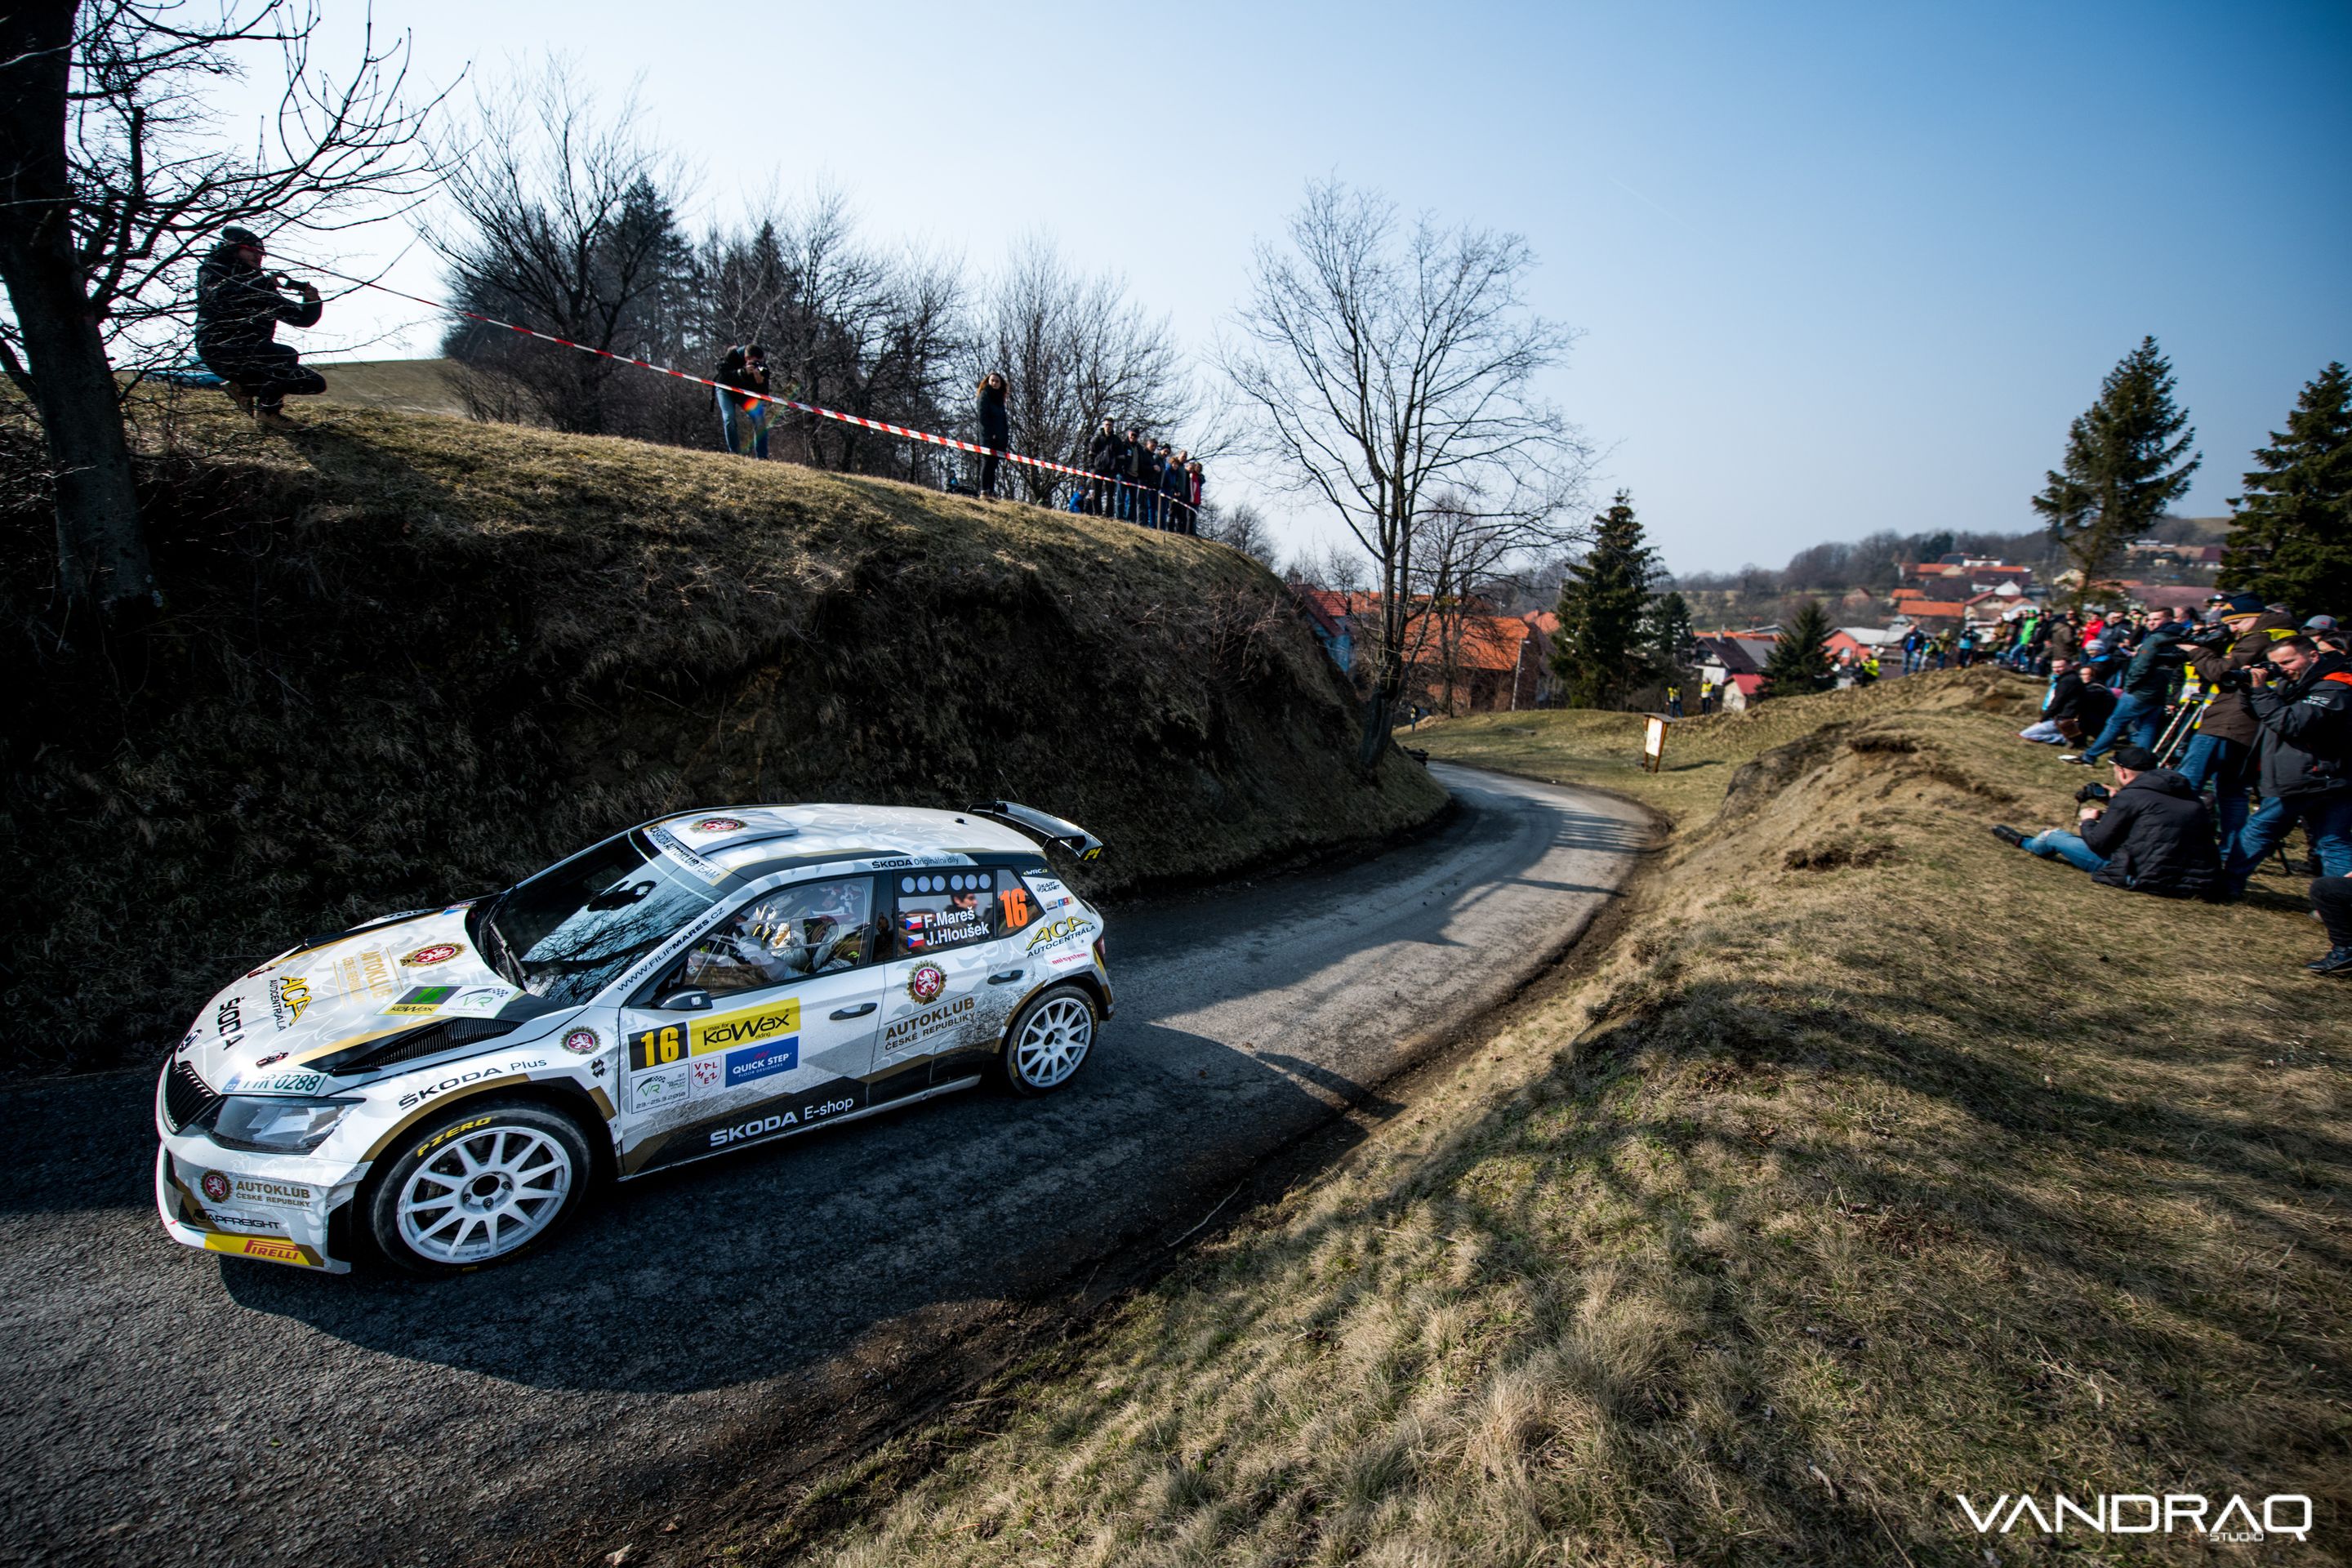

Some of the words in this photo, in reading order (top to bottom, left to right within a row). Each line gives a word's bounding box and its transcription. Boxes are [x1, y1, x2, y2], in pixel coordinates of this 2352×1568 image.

[694, 862, 720, 880] TEAM
[871, 859, 913, 869] ŠKODA
[924, 906, 975, 929] F.Mareš
[999, 888, 1028, 929] 16
[926, 921, 990, 946] J.Hloušek
[1026, 915, 1093, 951] ACA
[1027, 925, 1096, 958] AUTOCENTRÁLA
[279, 977, 313, 1027] ACA
[412, 987, 448, 1004] 16
[885, 997, 975, 1041] AUTOKLUB
[885, 1031, 918, 1051] ČESKÉ
[922, 1012, 976, 1036] REPUBLIKY
[640, 1027, 679, 1067] 16
[733, 1059, 765, 1075] QUICK
[768, 1054, 789, 1066] STEP
[756, 1062, 783, 1073] DESIGNERS
[274, 1074, 321, 1091] 0288
[399, 1067, 503, 1111] ŠKODA
[510, 1059, 547, 1071] Plus
[641, 1084, 661, 1097] VR
[804, 1098, 854, 1121] E-shop
[236, 1181, 310, 1199] AUTOKLUB
[236, 1192, 262, 1201] ČESKÉ
[266, 1196, 310, 1208] REPUBLIKY
[243, 1239, 300, 1260] PIRELLI
